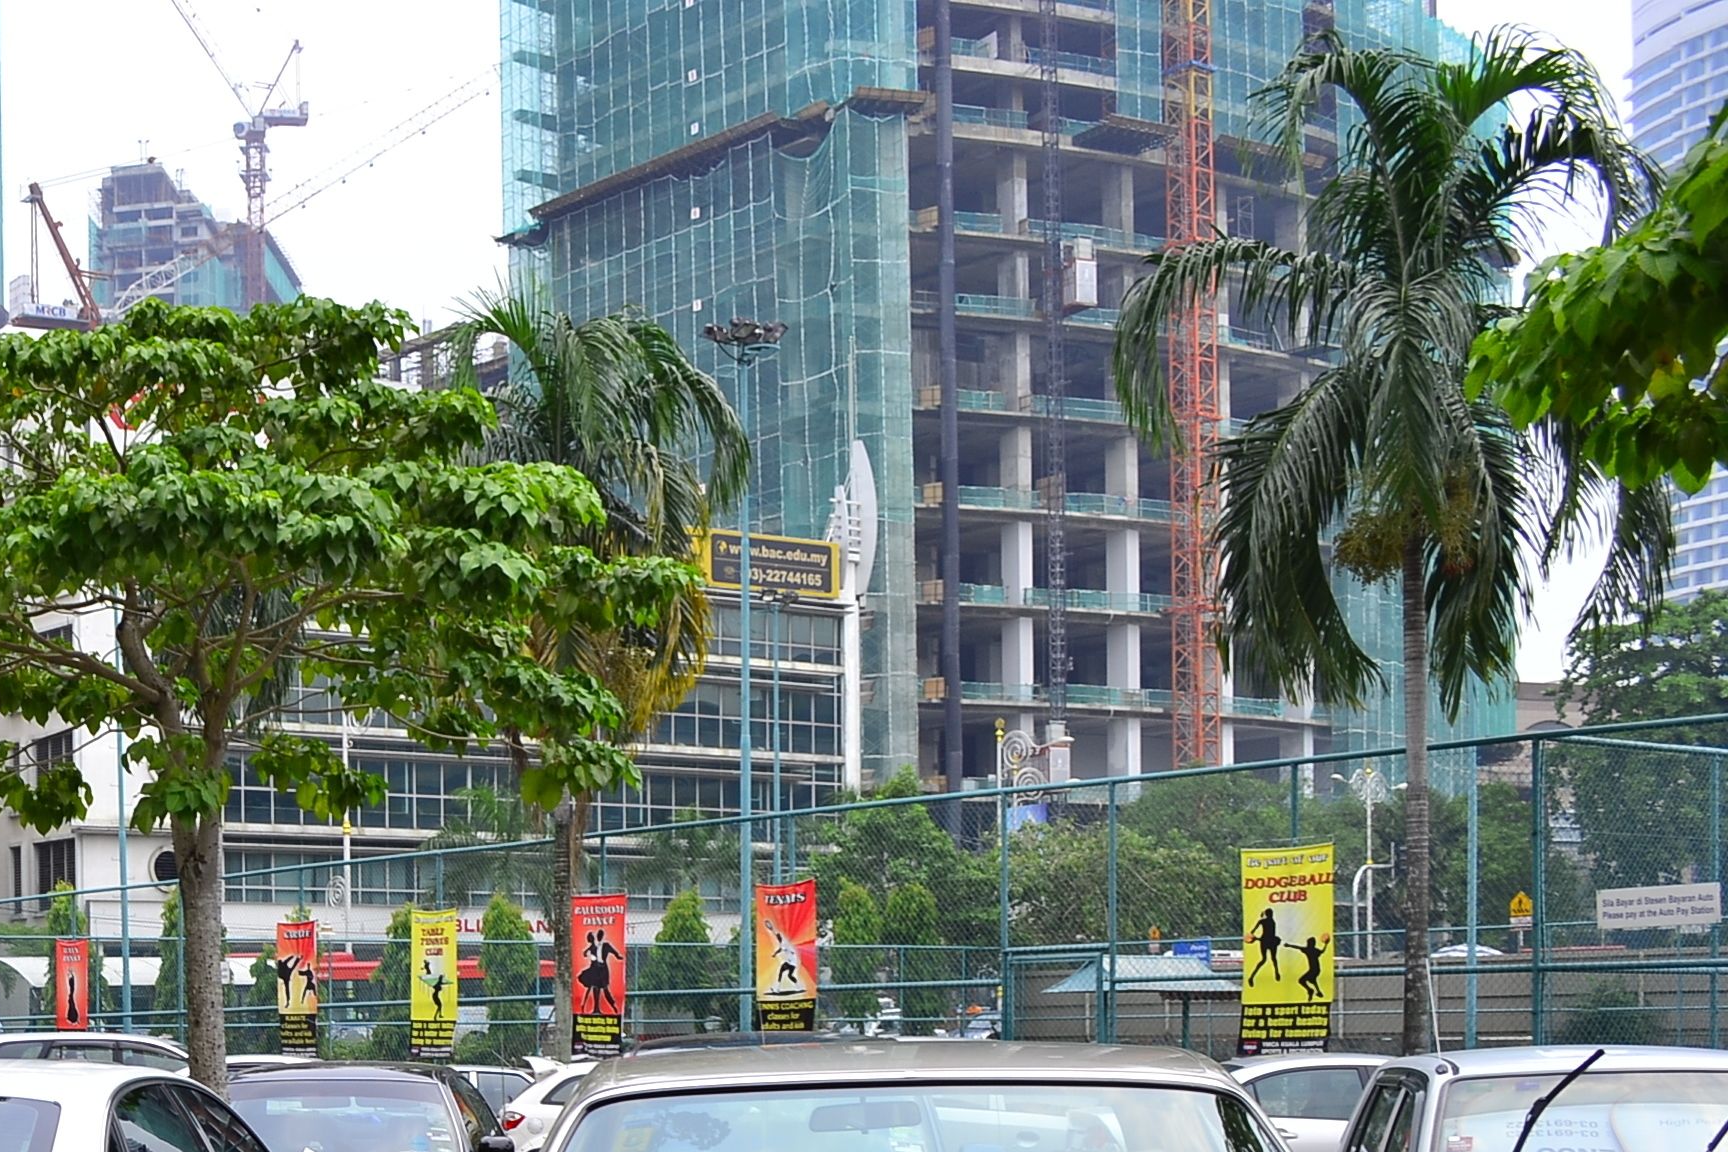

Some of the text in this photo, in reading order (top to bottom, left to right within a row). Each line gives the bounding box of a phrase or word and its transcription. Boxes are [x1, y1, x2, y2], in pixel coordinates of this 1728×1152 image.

[1244, 872, 1337, 889] DODGEBALL
[765, 892, 806, 904] TENNIS
[1268, 889, 1308, 903] CLUB
[1602, 899, 1614, 907] Sila
[1616, 898, 1634, 908] Bayar
[1644, 896, 1667, 905] Stesen
[1668, 895, 1696, 905] Bayaran
[574, 904, 624, 915] BALLROOM
[1602, 906, 1715, 920] Please pay at the Auto Pay Station
[582, 916, 615, 925] DANCE
[1244, 1006, 1263, 1016] Join
[1265, 1007, 1272, 1016] a
[1274, 1005, 1299, 1016] sport
[1296, 1016, 1328, 1027] healthy
[1284, 1028, 1328, 1038] tomorrow
